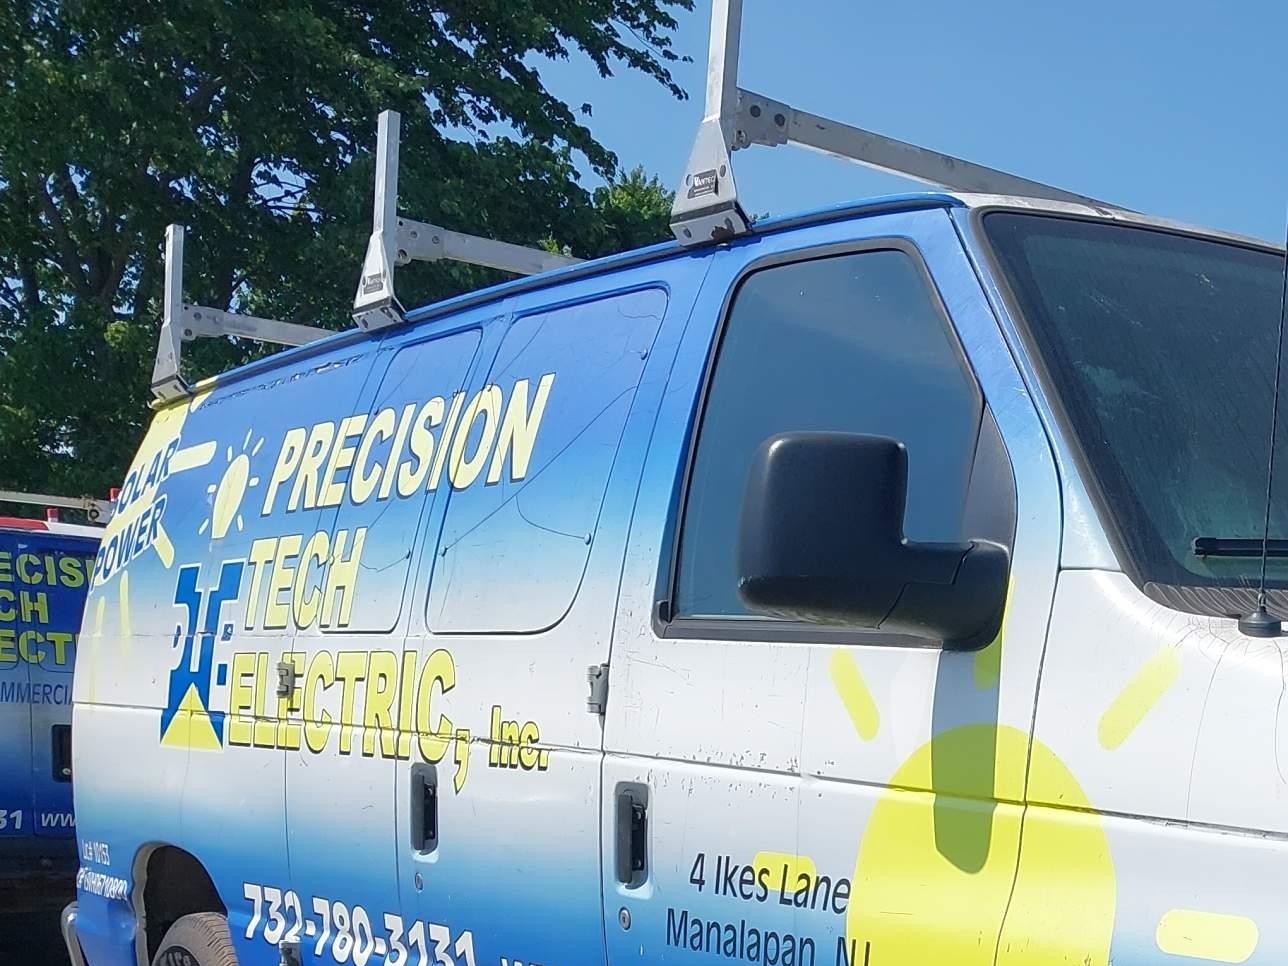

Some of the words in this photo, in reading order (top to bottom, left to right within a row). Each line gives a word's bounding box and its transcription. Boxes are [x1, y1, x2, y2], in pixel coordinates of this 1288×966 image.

[111, 436, 181, 515] OLAR
[260, 373, 556, 517] PRECISION
[92, 497, 166, 588] POWER
[244, 525, 368, 631] TECH
[0, 629, 79, 666] ECT
[0, 680, 73, 705] MMERCI
[228, 647, 470, 795] ELECTRIC,
[488, 704, 550, 771] Inc.
[689, 852, 706, 893] 4
[714, 856, 770, 903] Ikes
[778, 863, 851, 915] Lane
